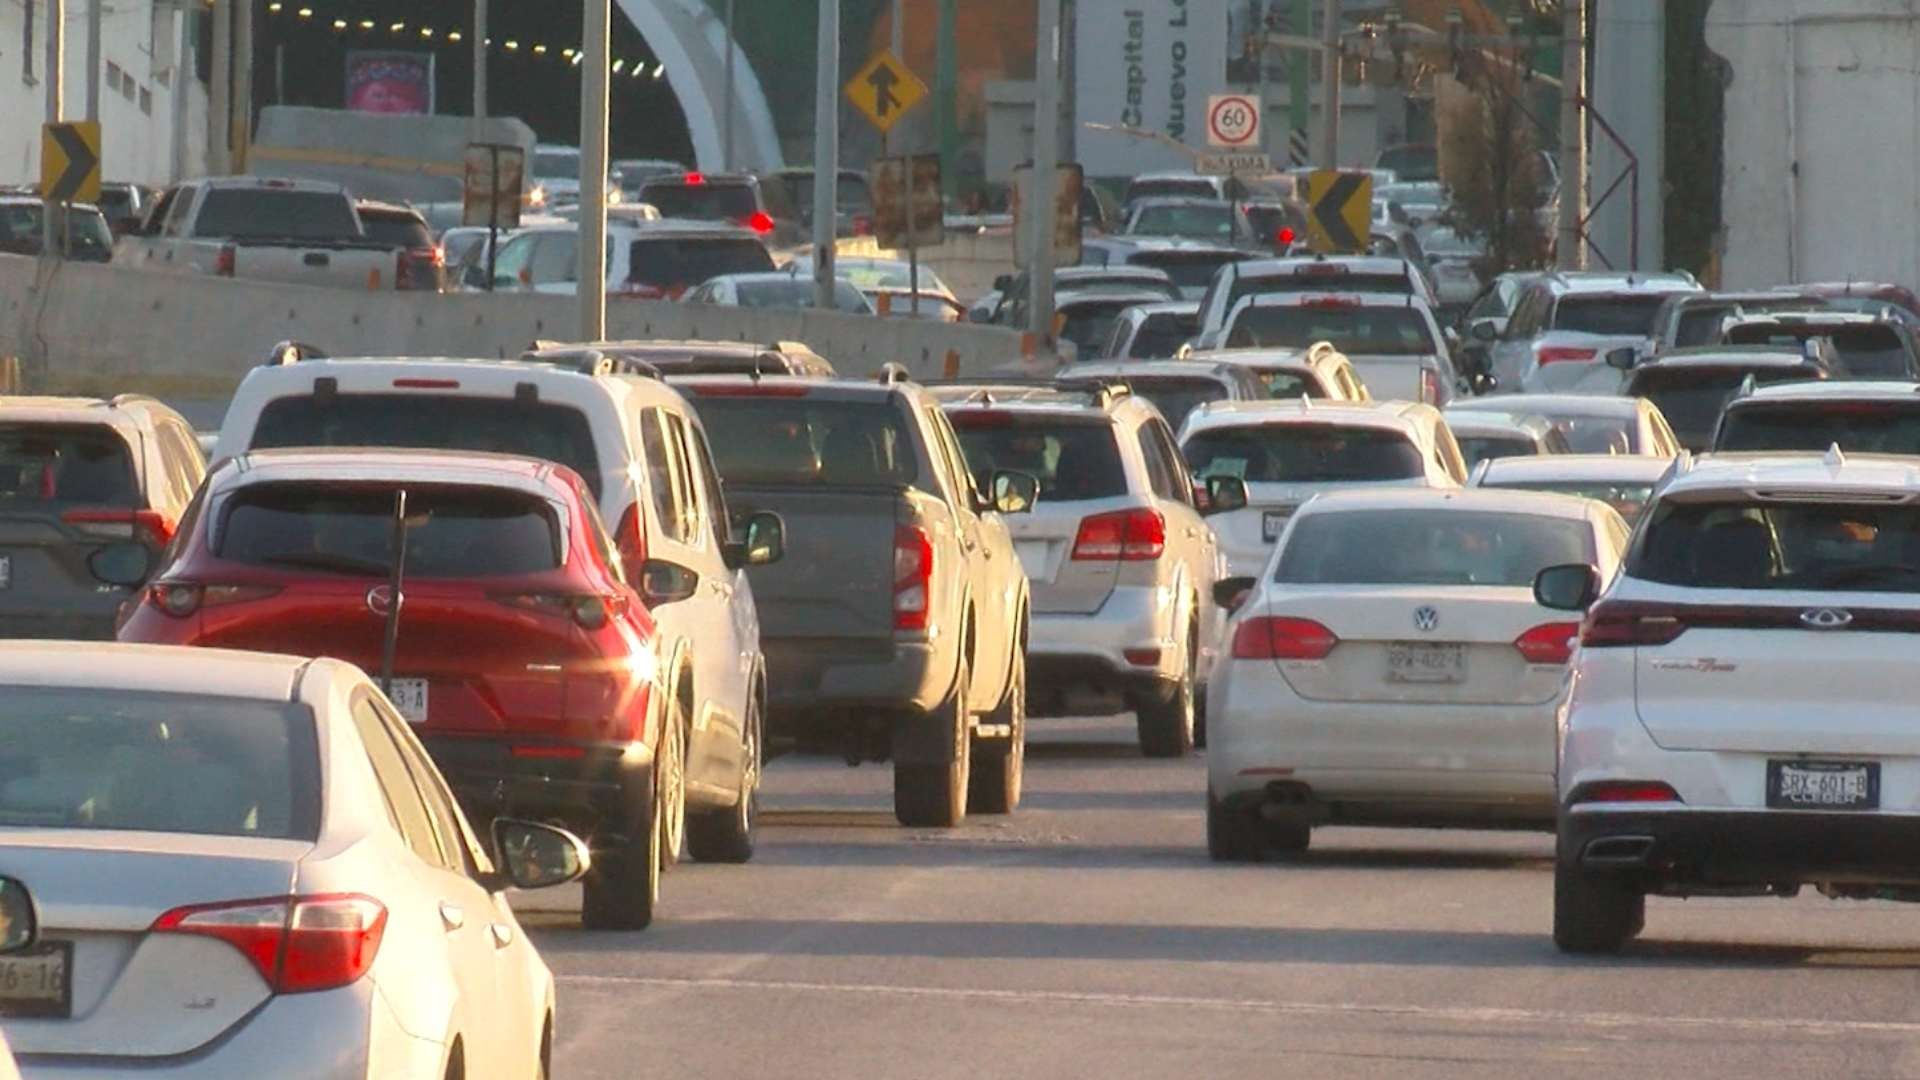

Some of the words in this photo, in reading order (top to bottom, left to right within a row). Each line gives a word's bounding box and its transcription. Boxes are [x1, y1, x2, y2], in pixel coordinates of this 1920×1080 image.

[1121, 10, 1147, 128] Capital
[1166, 40, 1187, 143] Nuevo
[1222, 107, 1245, 127] 60
